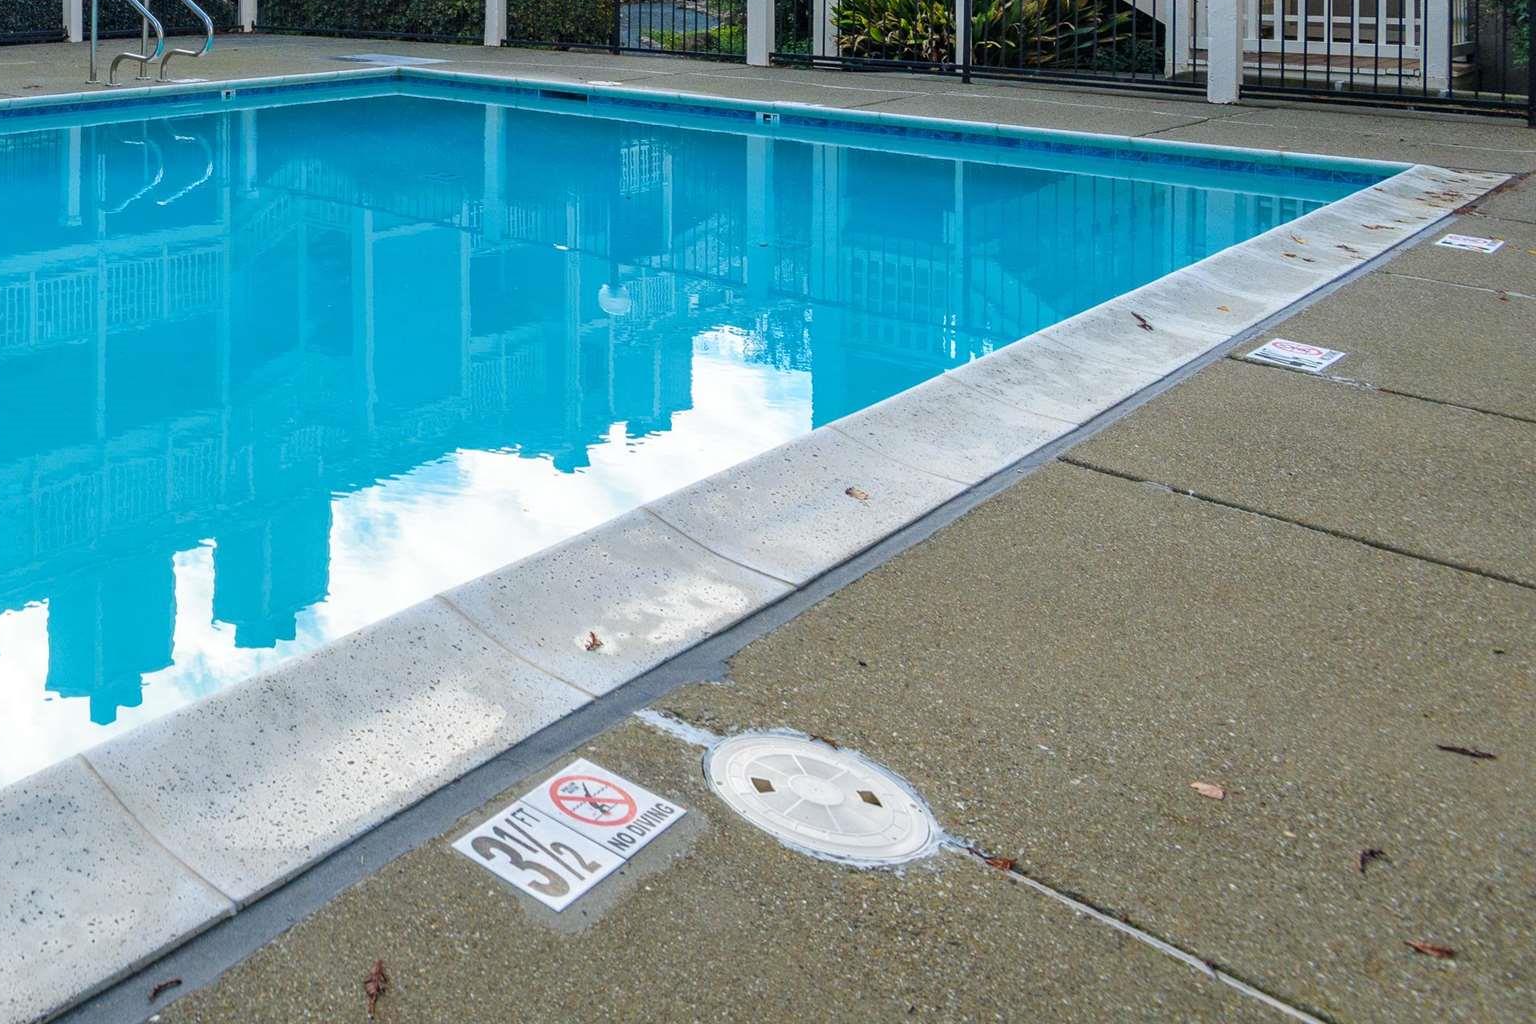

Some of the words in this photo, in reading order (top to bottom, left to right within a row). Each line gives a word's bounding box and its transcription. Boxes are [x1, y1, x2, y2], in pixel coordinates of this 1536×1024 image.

[511, 807, 541, 828] FT
[607, 831, 637, 852] NO
[630, 802, 675, 838] DIVING
